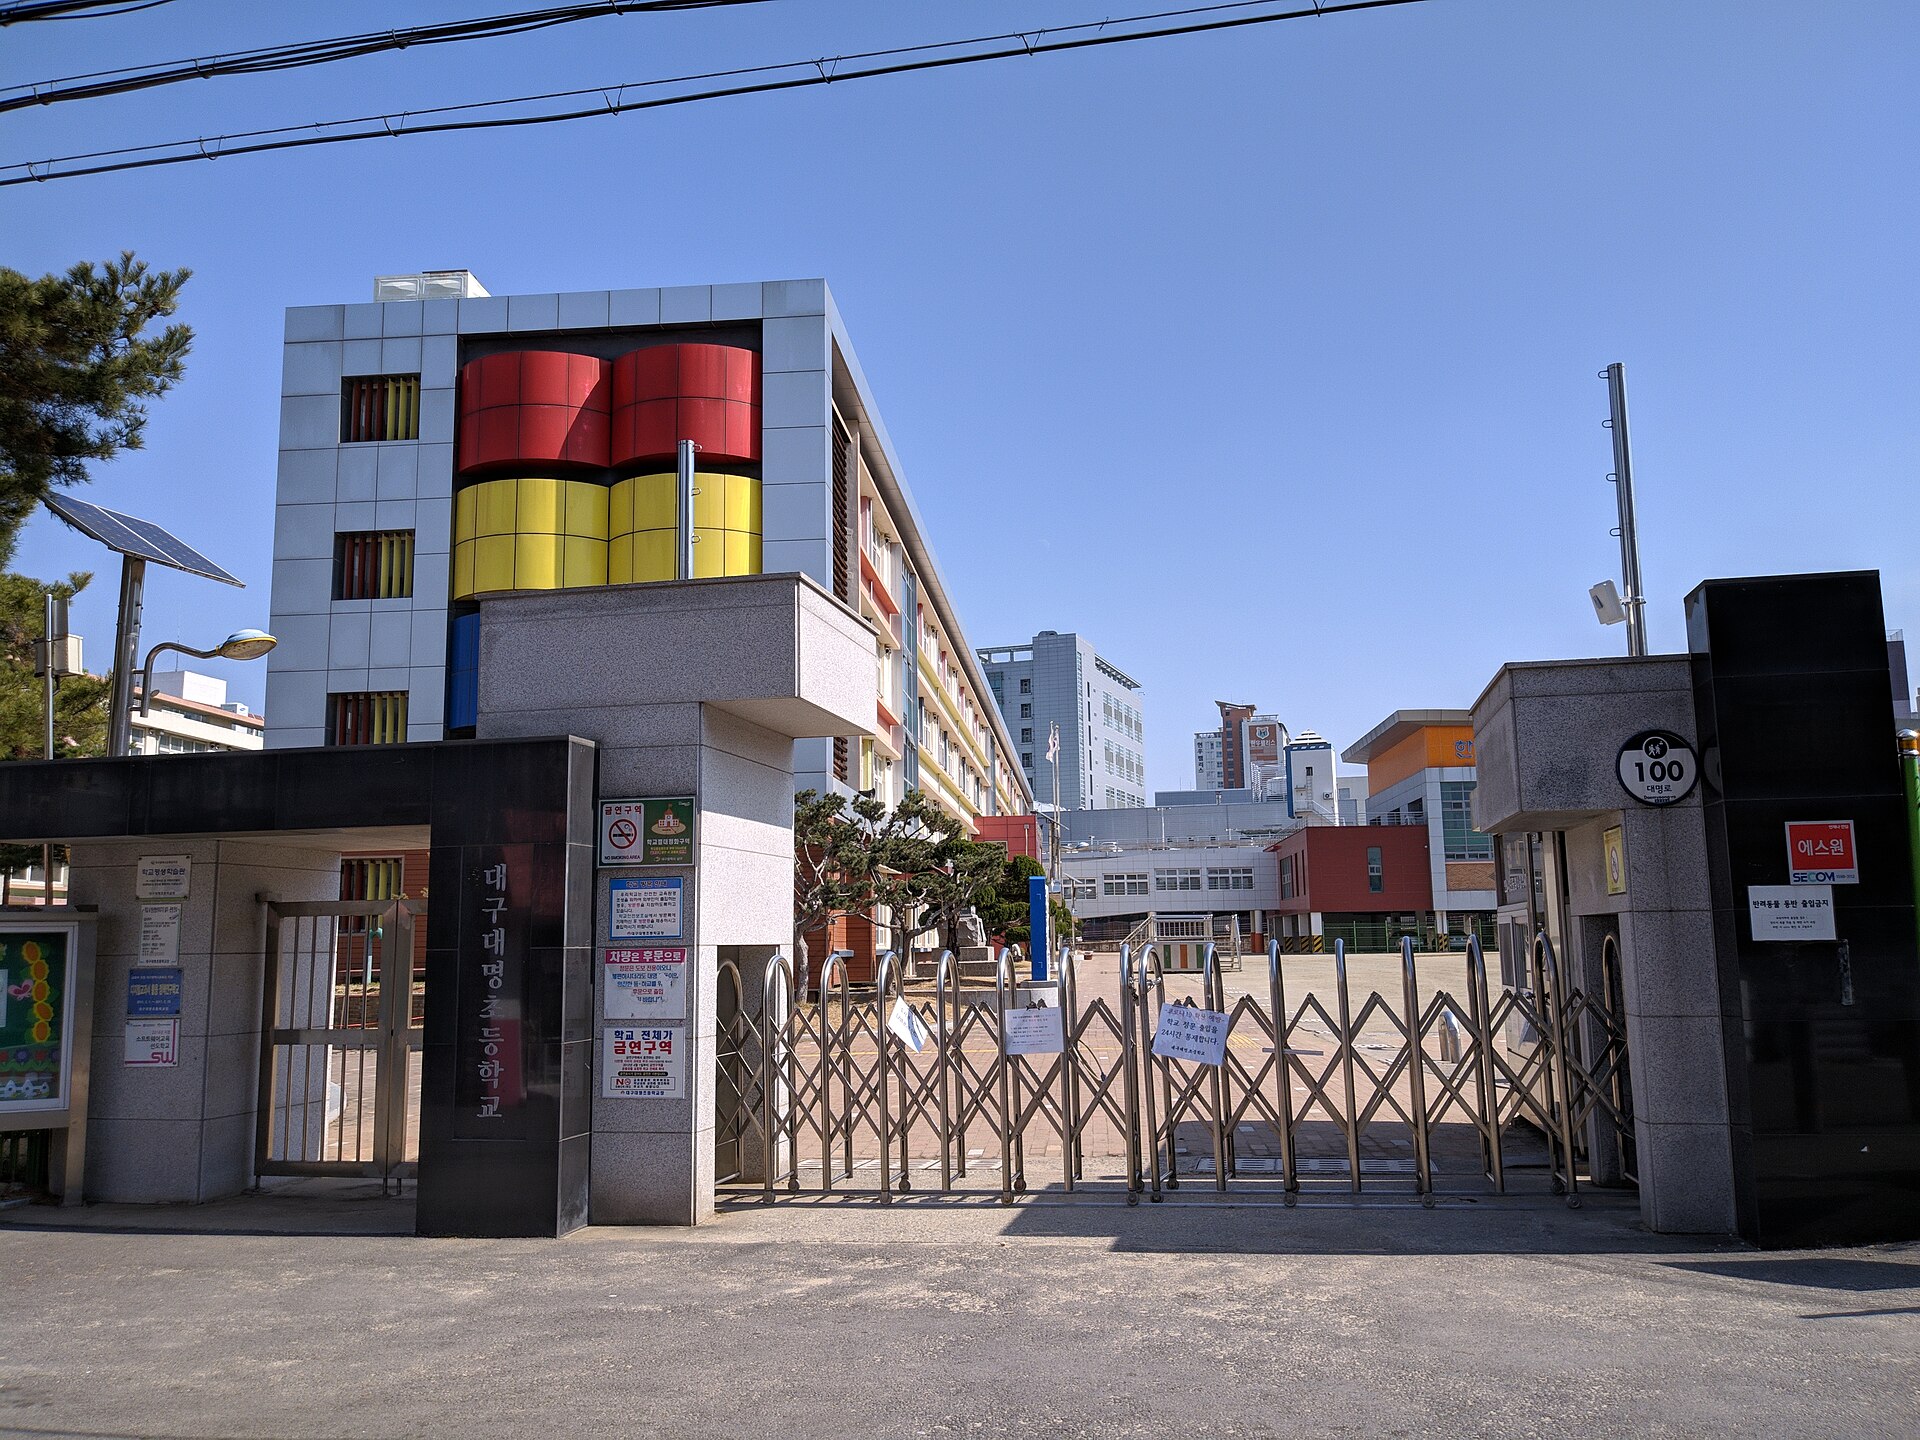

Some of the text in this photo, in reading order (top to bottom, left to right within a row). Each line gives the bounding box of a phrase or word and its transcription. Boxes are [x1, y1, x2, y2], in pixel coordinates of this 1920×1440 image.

[1634, 760, 1684, 782] 100
[1646, 784, 1672, 794] 대명로
[604, 805, 642, 816] 금연구역
[1798, 838, 1844, 856] 에스원
[1792, 872, 1835, 882] SECOM
[1752, 899, 1829, 909] 반려동물 동반 출입금지
[610, 950, 681, 962] 차량은 후문으로
[476, 863, 508, 1118] 대구대명초등학교
[1167, 1018, 1218, 1034] 학교 정문 출입을
[614, 1030, 673, 1040] 학교 전체가
[1161, 1029, 1219, 1046] 24시간 통제합니다.
[614, 1040, 672, 1055] 금연구역
